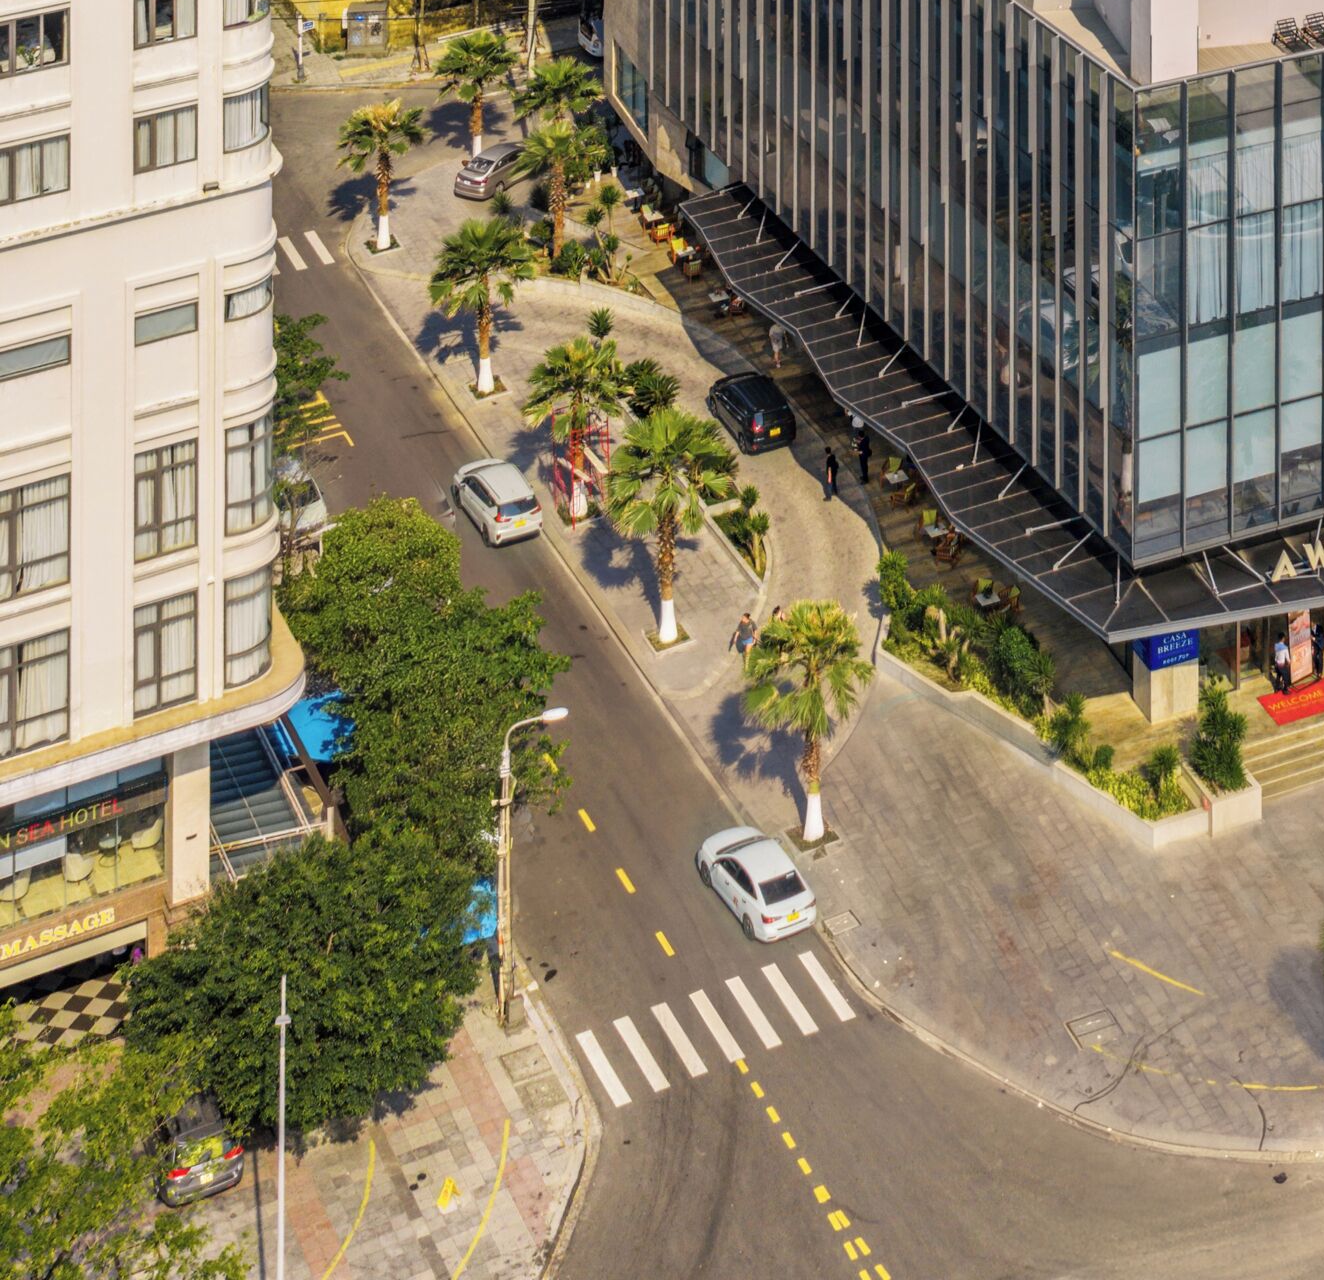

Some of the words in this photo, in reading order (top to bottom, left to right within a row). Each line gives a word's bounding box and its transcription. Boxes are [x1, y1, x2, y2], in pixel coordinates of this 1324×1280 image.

[1157, 637, 1194, 654] BREEZE
[1163, 631, 1187, 644] CASA
[15, 819, 55, 845] SEA
[60, 797, 124, 832] HOTEL
[0, 907, 115, 960] MASSAGE
